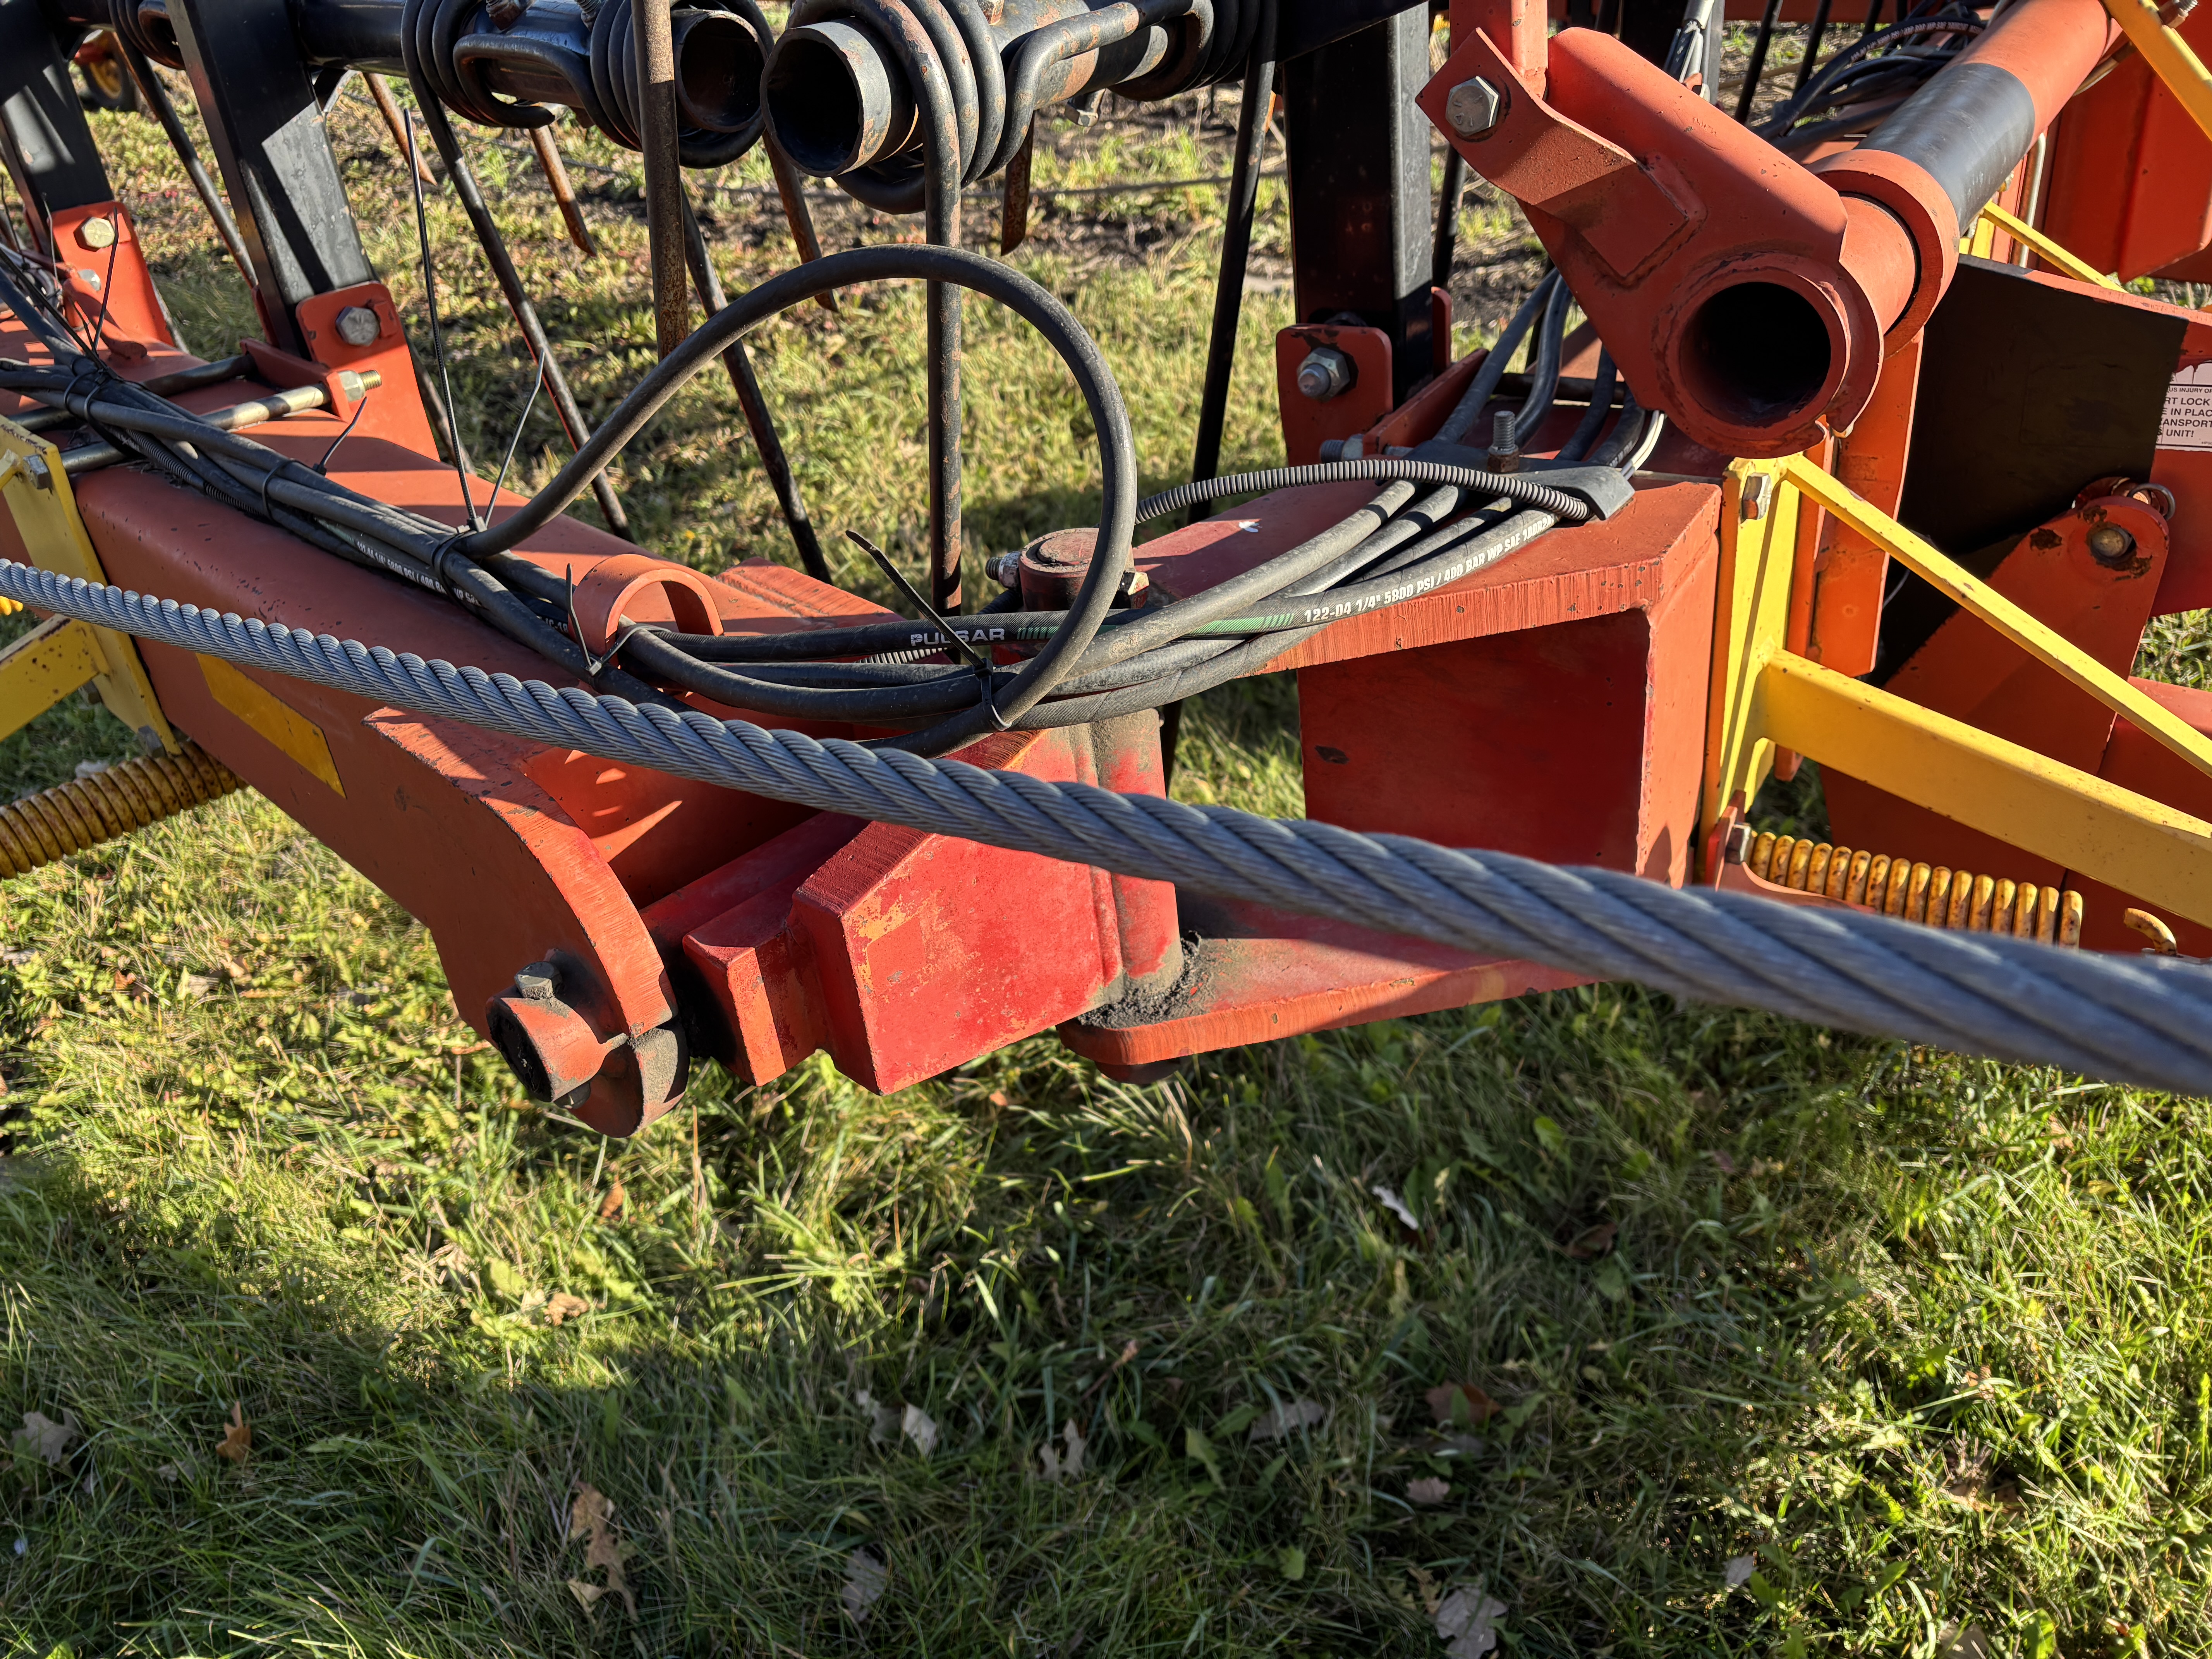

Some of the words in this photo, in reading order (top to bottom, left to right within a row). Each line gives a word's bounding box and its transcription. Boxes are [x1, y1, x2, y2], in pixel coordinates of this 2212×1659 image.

[2181, 398, 2210, 406] LOCK
[2166, 429, 2194, 437] UNIT!
[1304, 602, 1351, 622] 122-04
[1384, 584, 1414, 604] 5800
[1417, 575, 1435, 594] PSI
[1444, 563, 1463, 582] 400
[1465, 553, 1486, 573] BAR
[1487, 543, 1503, 561] WP
[1504, 532, 1520, 552] SAE
[910, 628, 1005, 646] PULSAR
